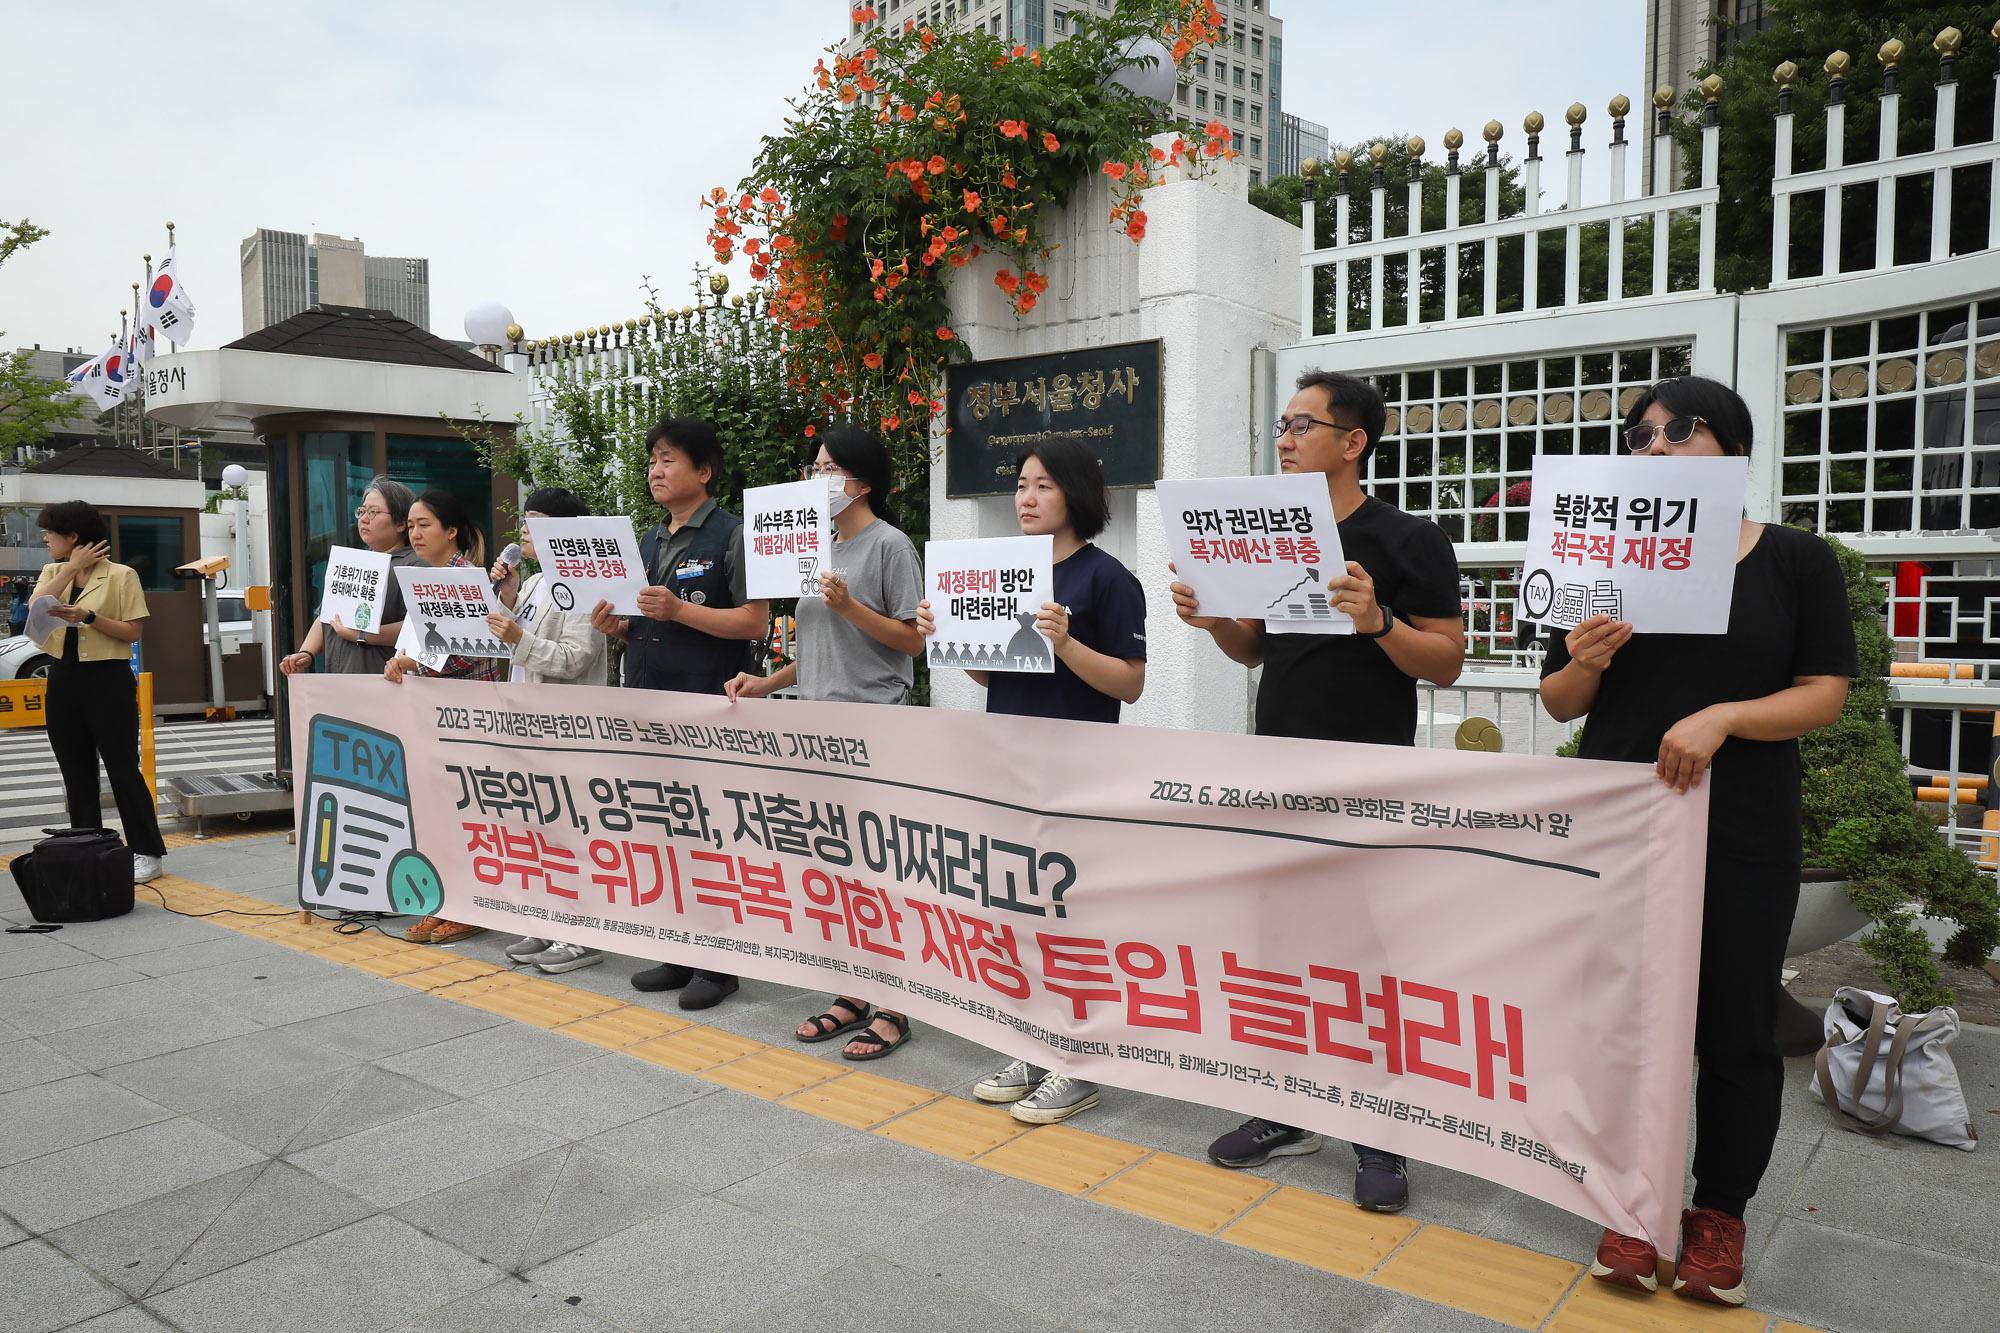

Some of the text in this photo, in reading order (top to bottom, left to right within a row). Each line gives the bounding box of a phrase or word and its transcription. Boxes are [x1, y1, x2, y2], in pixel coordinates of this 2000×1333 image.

[967, 367, 1140, 420] 정부서울청사
[753, 507, 818, 534] 세수부족 지속
[1182, 506, 1313, 535] 약자 권리보장
[1553, 494, 1698, 533] 복합적 위기
[549, 538, 622, 558] 민영화 철회
[754, 530, 819, 556] 재벌감세 반복
[1190, 537, 1321, 564] 복지예산 확충
[1551, 532, 1692, 570] 적극적 재정
[334, 565, 379, 585] 기후위기 대응
[556, 559, 627, 579] 공공성 강화
[800, 560, 811, 569] TAX
[331, 580, 376, 602] 생태예산 확충
[412, 584, 484, 601] 부자감세 철회
[937, 568, 1034, 594] 재정확대 방안
[1530, 585, 1548, 601] TAX
[555, 591, 570, 601] TAX
[951, 596, 1018, 620] 마련하라!
[418, 602, 490, 618] 재정확충 모색
[430, 645, 447, 654] TAX
[1014, 656, 1044, 670] TAX
[436, 707, 870, 767] 2023 국가재정전략회의 대응 노동시민사회단체 기자회견
[322, 729, 398, 789] TAX
[1150, 780, 1573, 838] 2023. 6. 28.(수) 09:30 광화문 정부서울청사 앞
[445, 765, 1076, 918] 기후위기, 양극화, 저출생 어쩌려고?
[461, 822, 1528, 1104] 정부는 위기 극복 위한 재정 투입 늘려라!
[603, 920, 655, 939] 동물권행동카라,
[659, 928, 690, 945] 민주노총,
[693, 934, 762, 957] 보건의료단체연합,
[765, 946, 852, 976] 복지국가청년네트워크,
[853, 964, 906, 992] 빈곤사회연대,
[1117, 1044, 1174, 1068] 참여연대,
[1179, 1053, 1278, 1091] 함께살기연구소,
[1284, 1075, 1344, 1107] 한국노총,
[1350, 1090, 1494, 1147] 한국비정규노동센터,
